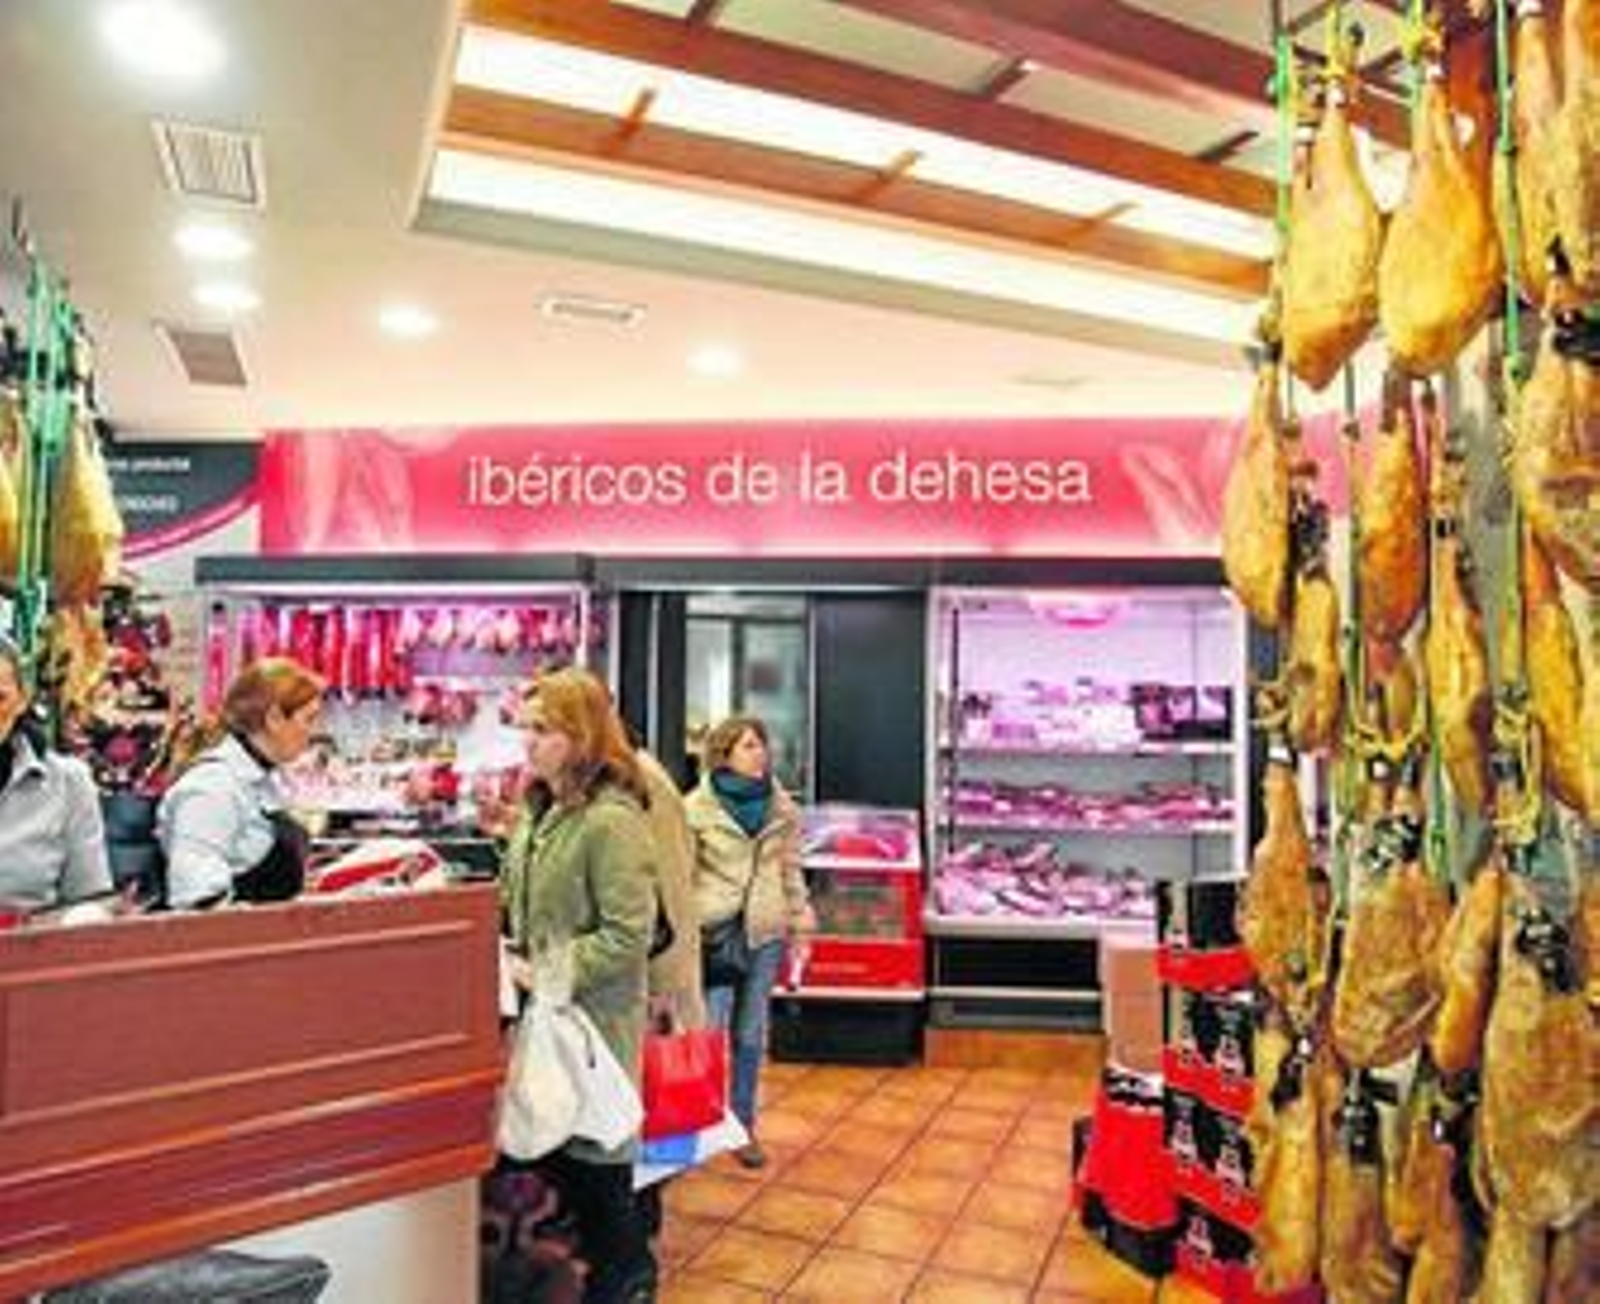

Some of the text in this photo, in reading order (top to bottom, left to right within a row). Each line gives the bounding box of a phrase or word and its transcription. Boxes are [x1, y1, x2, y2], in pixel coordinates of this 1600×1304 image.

[469, 448, 1093, 505] ibéricos de la dehesa
